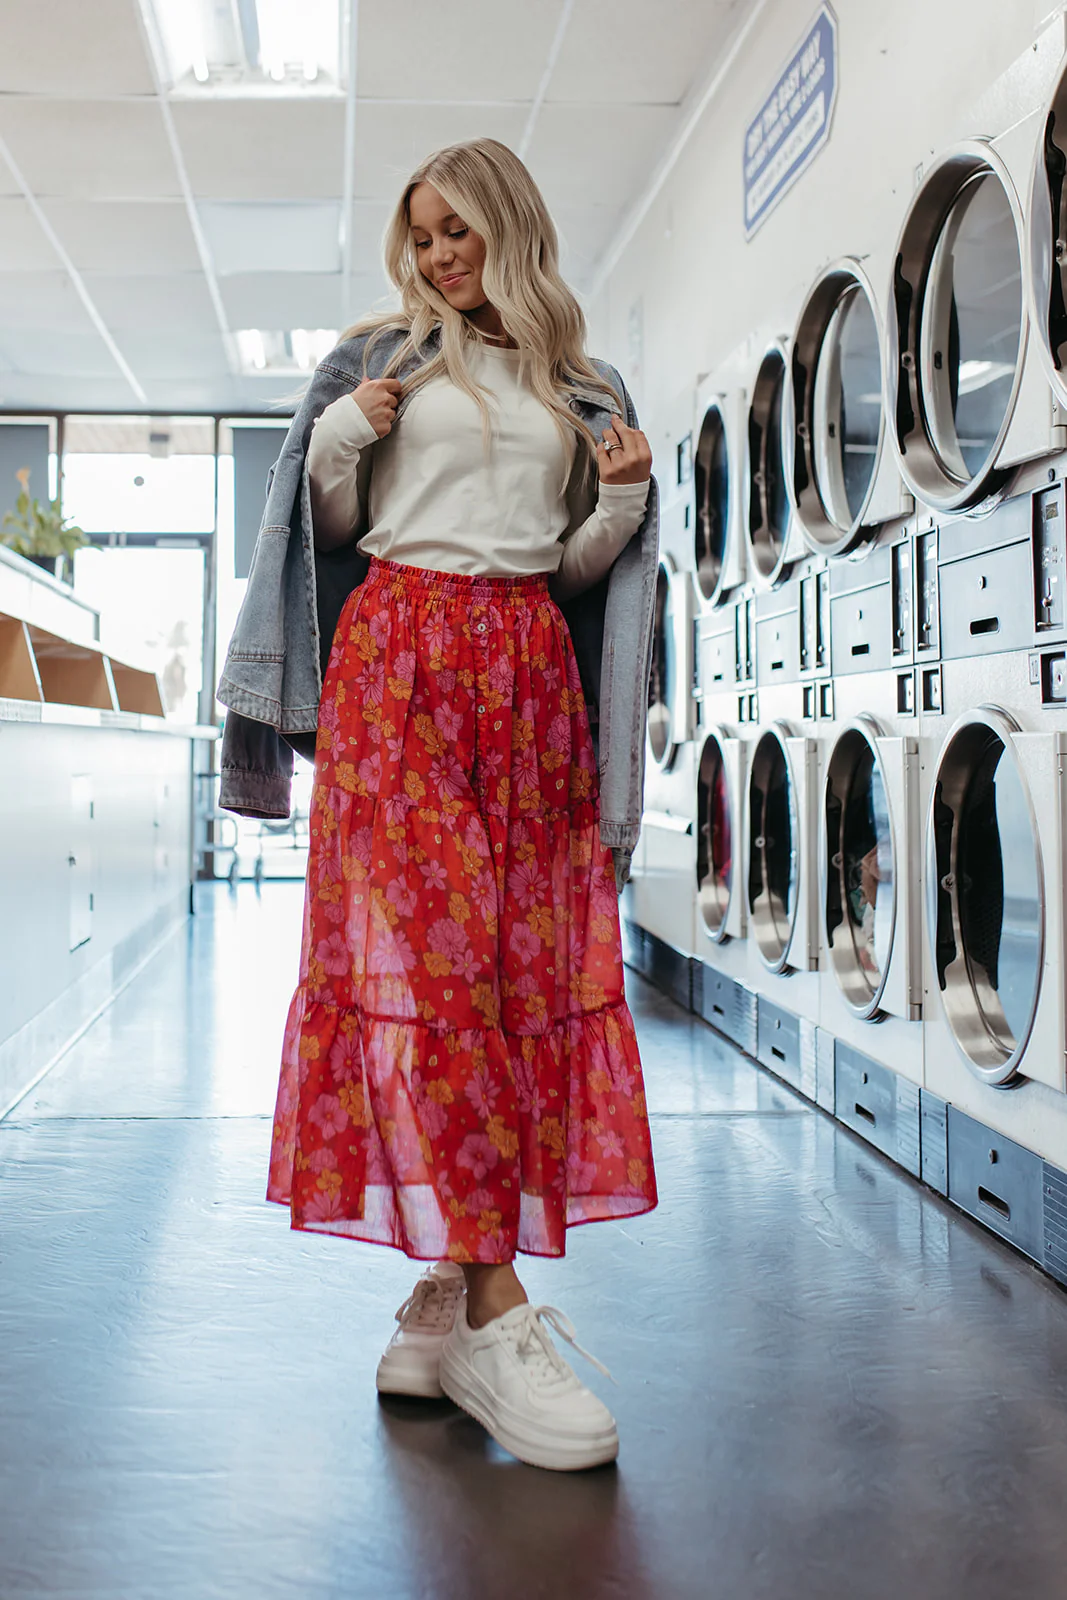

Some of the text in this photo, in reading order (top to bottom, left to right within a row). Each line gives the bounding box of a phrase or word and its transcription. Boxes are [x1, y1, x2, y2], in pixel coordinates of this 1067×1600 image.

[761, 95, 779, 134] THE
[778, 60, 800, 113] EASY
[800, 30, 821, 77] WAY
